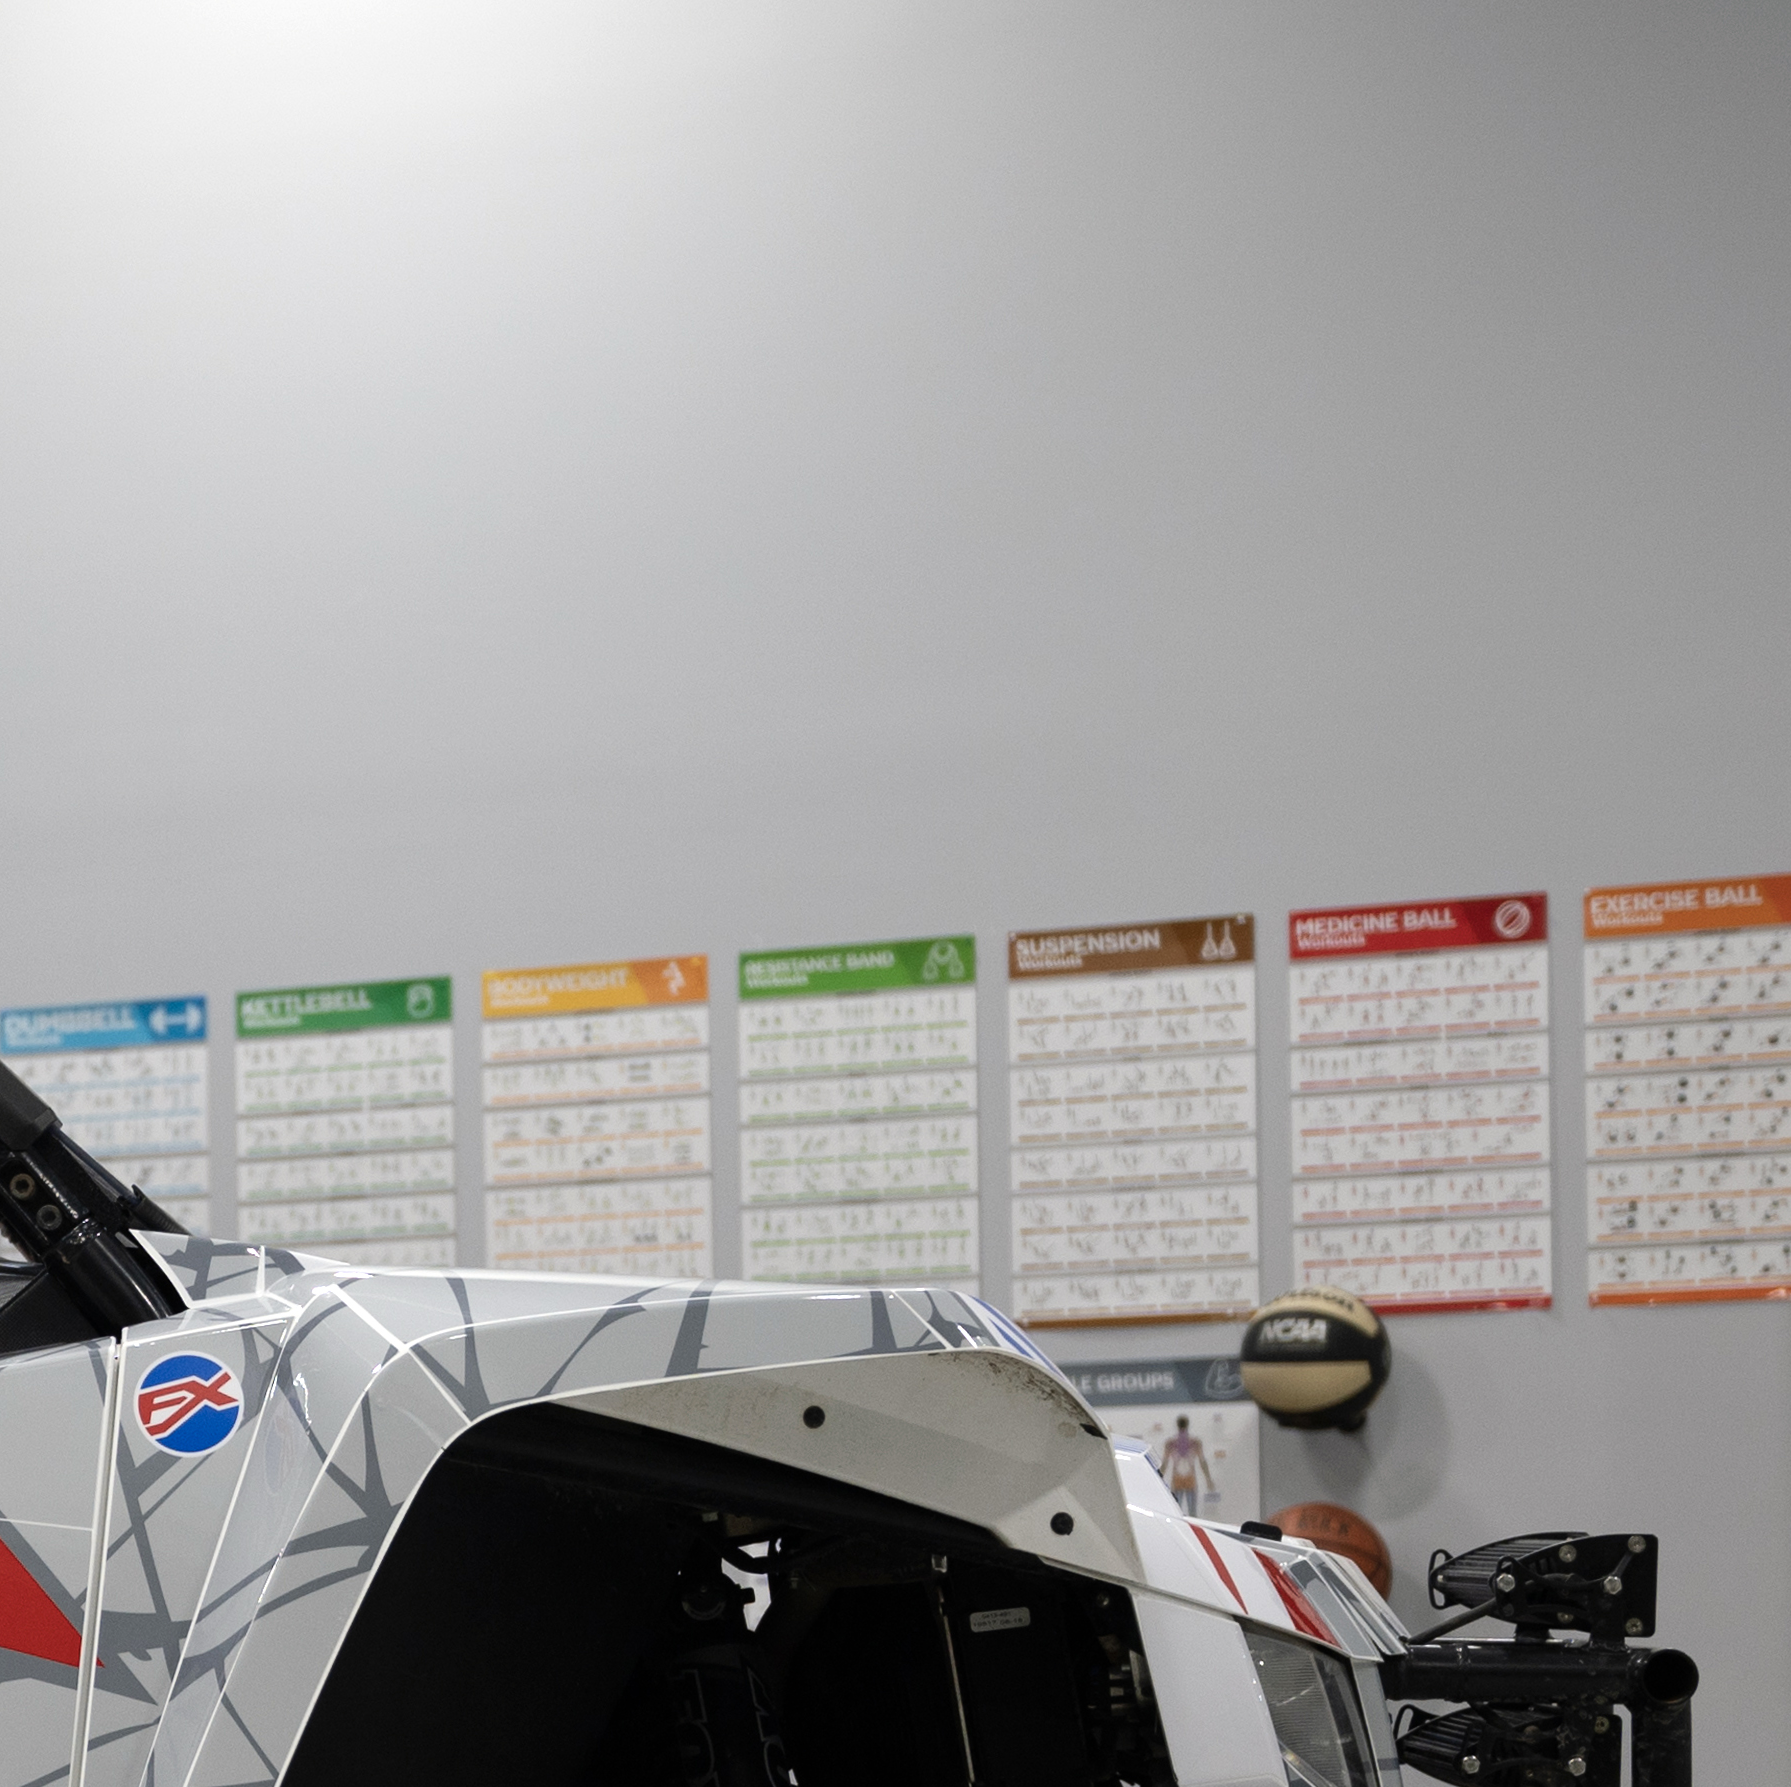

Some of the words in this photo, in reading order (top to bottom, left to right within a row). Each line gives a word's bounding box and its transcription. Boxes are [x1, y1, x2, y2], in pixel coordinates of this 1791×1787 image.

[1590, 891, 1700, 916] EXERCISE
[1705, 884, 1764, 908] BALL
[1295, 910, 1399, 936] MEDICINE
[1403, 906, 1457, 930] BALL
[1592, 910, 1665, 930] Workouts
[1016, 928, 1161, 957] SUSPENSION
[846, 949, 895, 971] BAND
[1097, 1370, 1175, 1394] GROUPS
